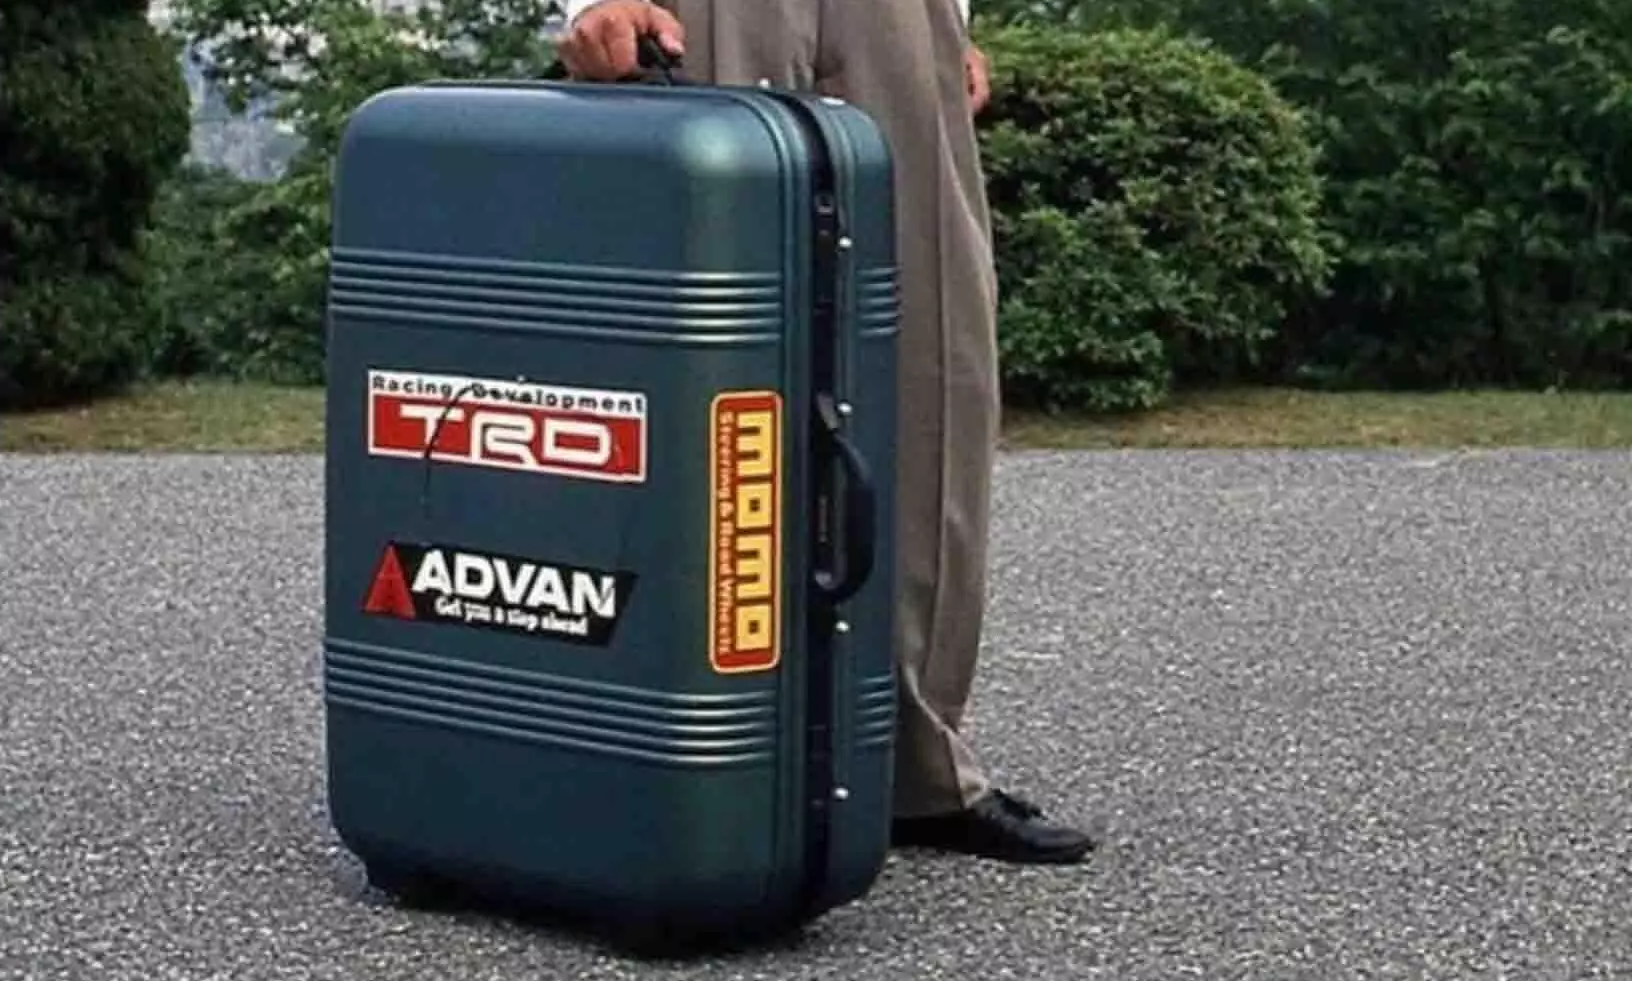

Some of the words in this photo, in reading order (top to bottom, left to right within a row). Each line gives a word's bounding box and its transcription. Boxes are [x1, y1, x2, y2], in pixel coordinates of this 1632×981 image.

[371, 375, 453, 399] Racing
[469, 383, 644, 413] Development
[399, 403, 612, 469] TRD
[412, 549, 616, 617] ADVAN
[434, 596, 462, 617] Get
